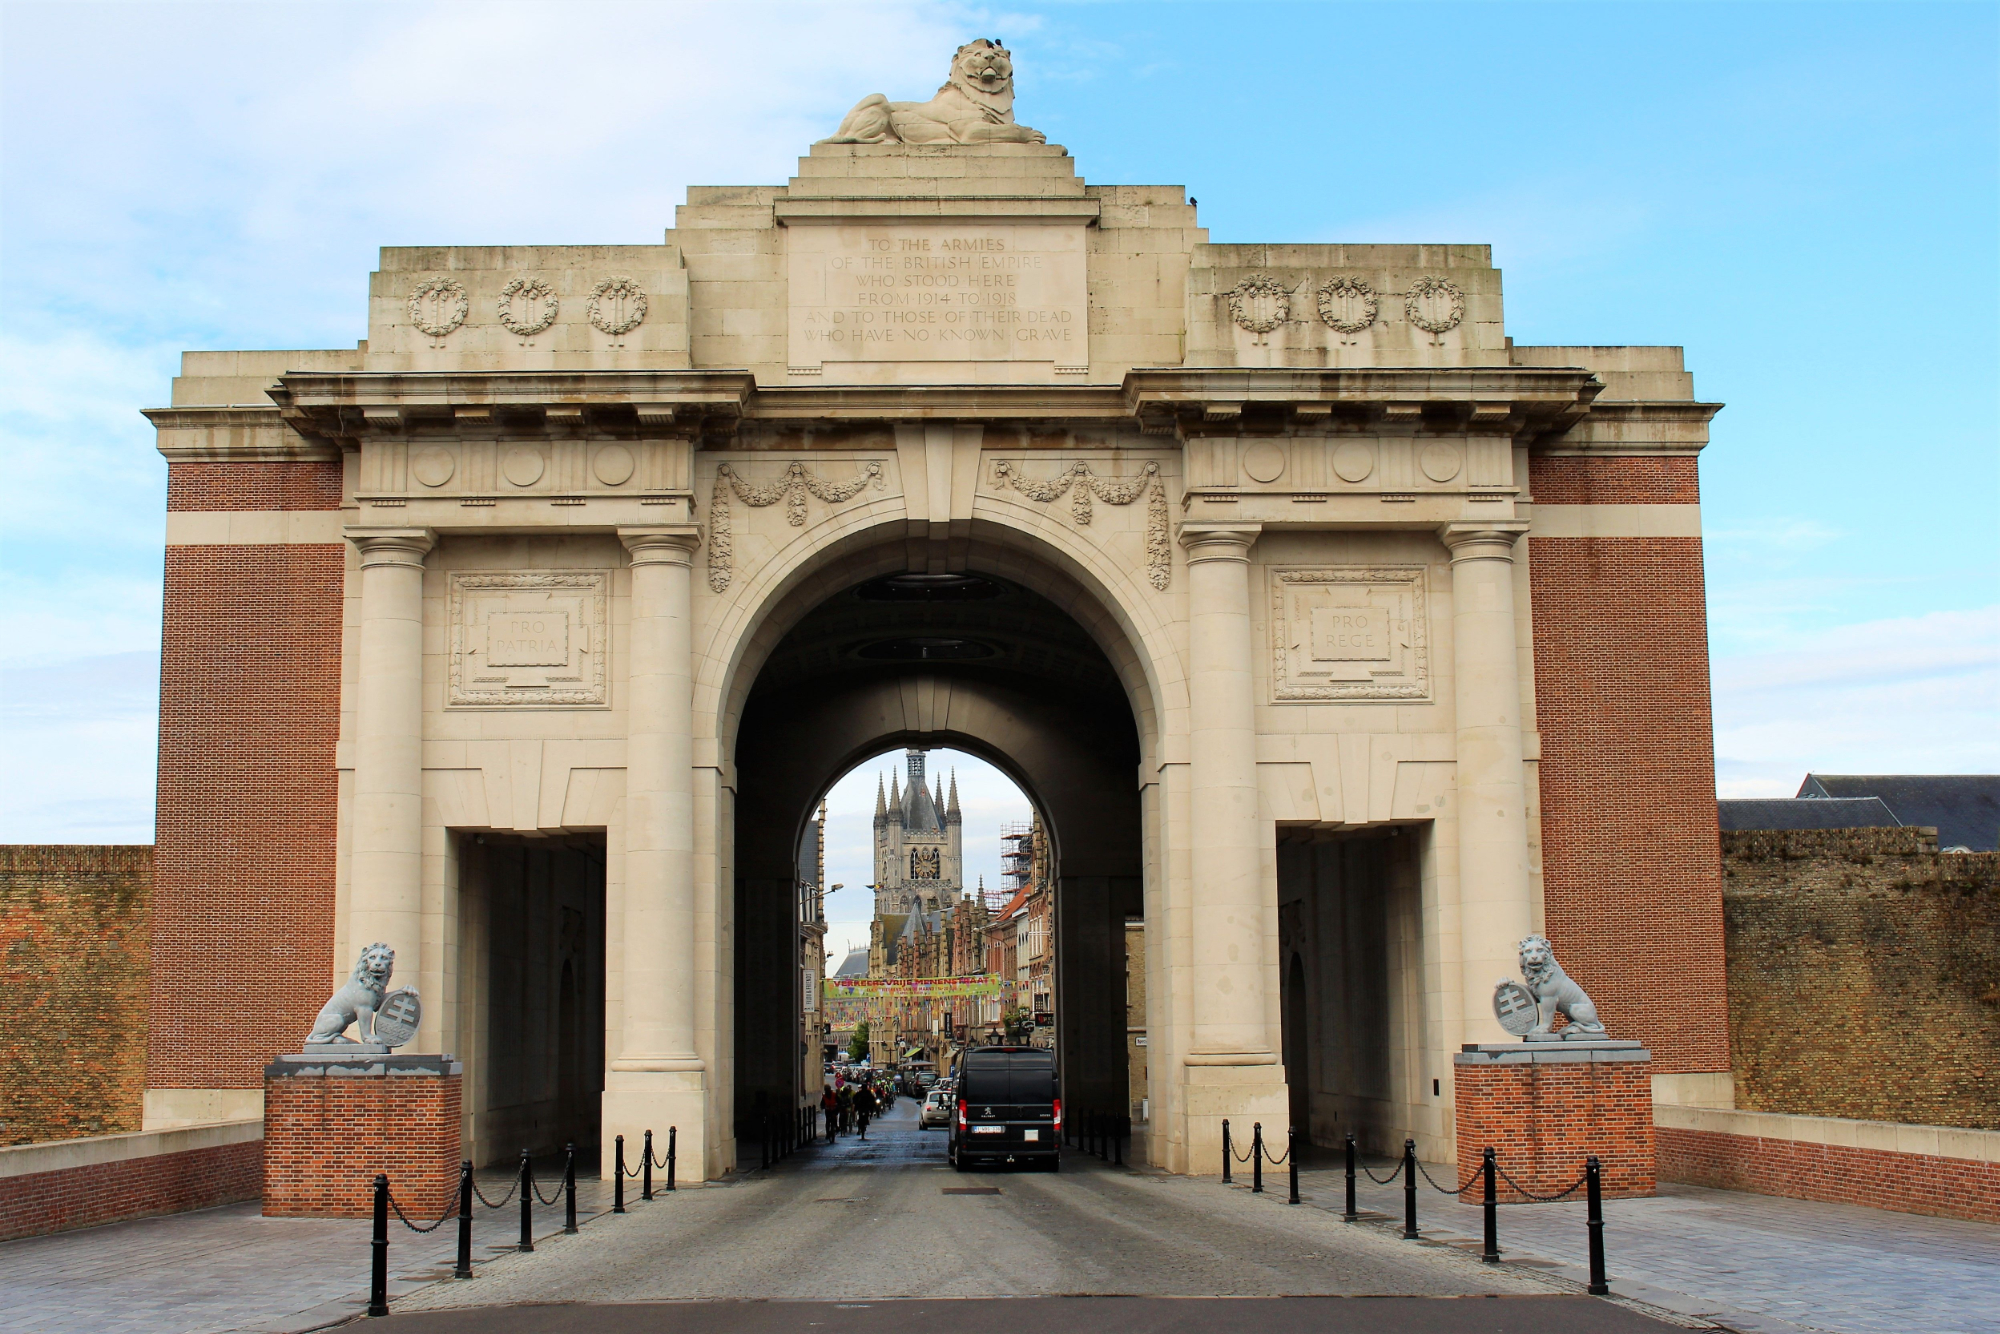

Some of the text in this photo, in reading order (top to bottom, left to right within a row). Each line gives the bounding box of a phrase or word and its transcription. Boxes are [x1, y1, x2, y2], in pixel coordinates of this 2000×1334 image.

[868, 238, 1005, 251] TO THE ARMIES
[831, 256, 1042, 269] OF THE BRITISH EMPIRE
[856, 274, 1015, 287] WHO STOOD HERE
[858, 291, 1016, 305] FROM 1914 TO 1918
[804, 310, 1072, 324] AND TO THOSE OF THEIR DEAD
[804, 328, 1072, 341] WHO HAVE NO KNOWN GRAVE
[511, 621, 545, 633] PRO
[1333, 616, 1368, 628] PRO
[497, 640, 557, 652] PATRIA
[1327, 635, 1375, 647] REGE
